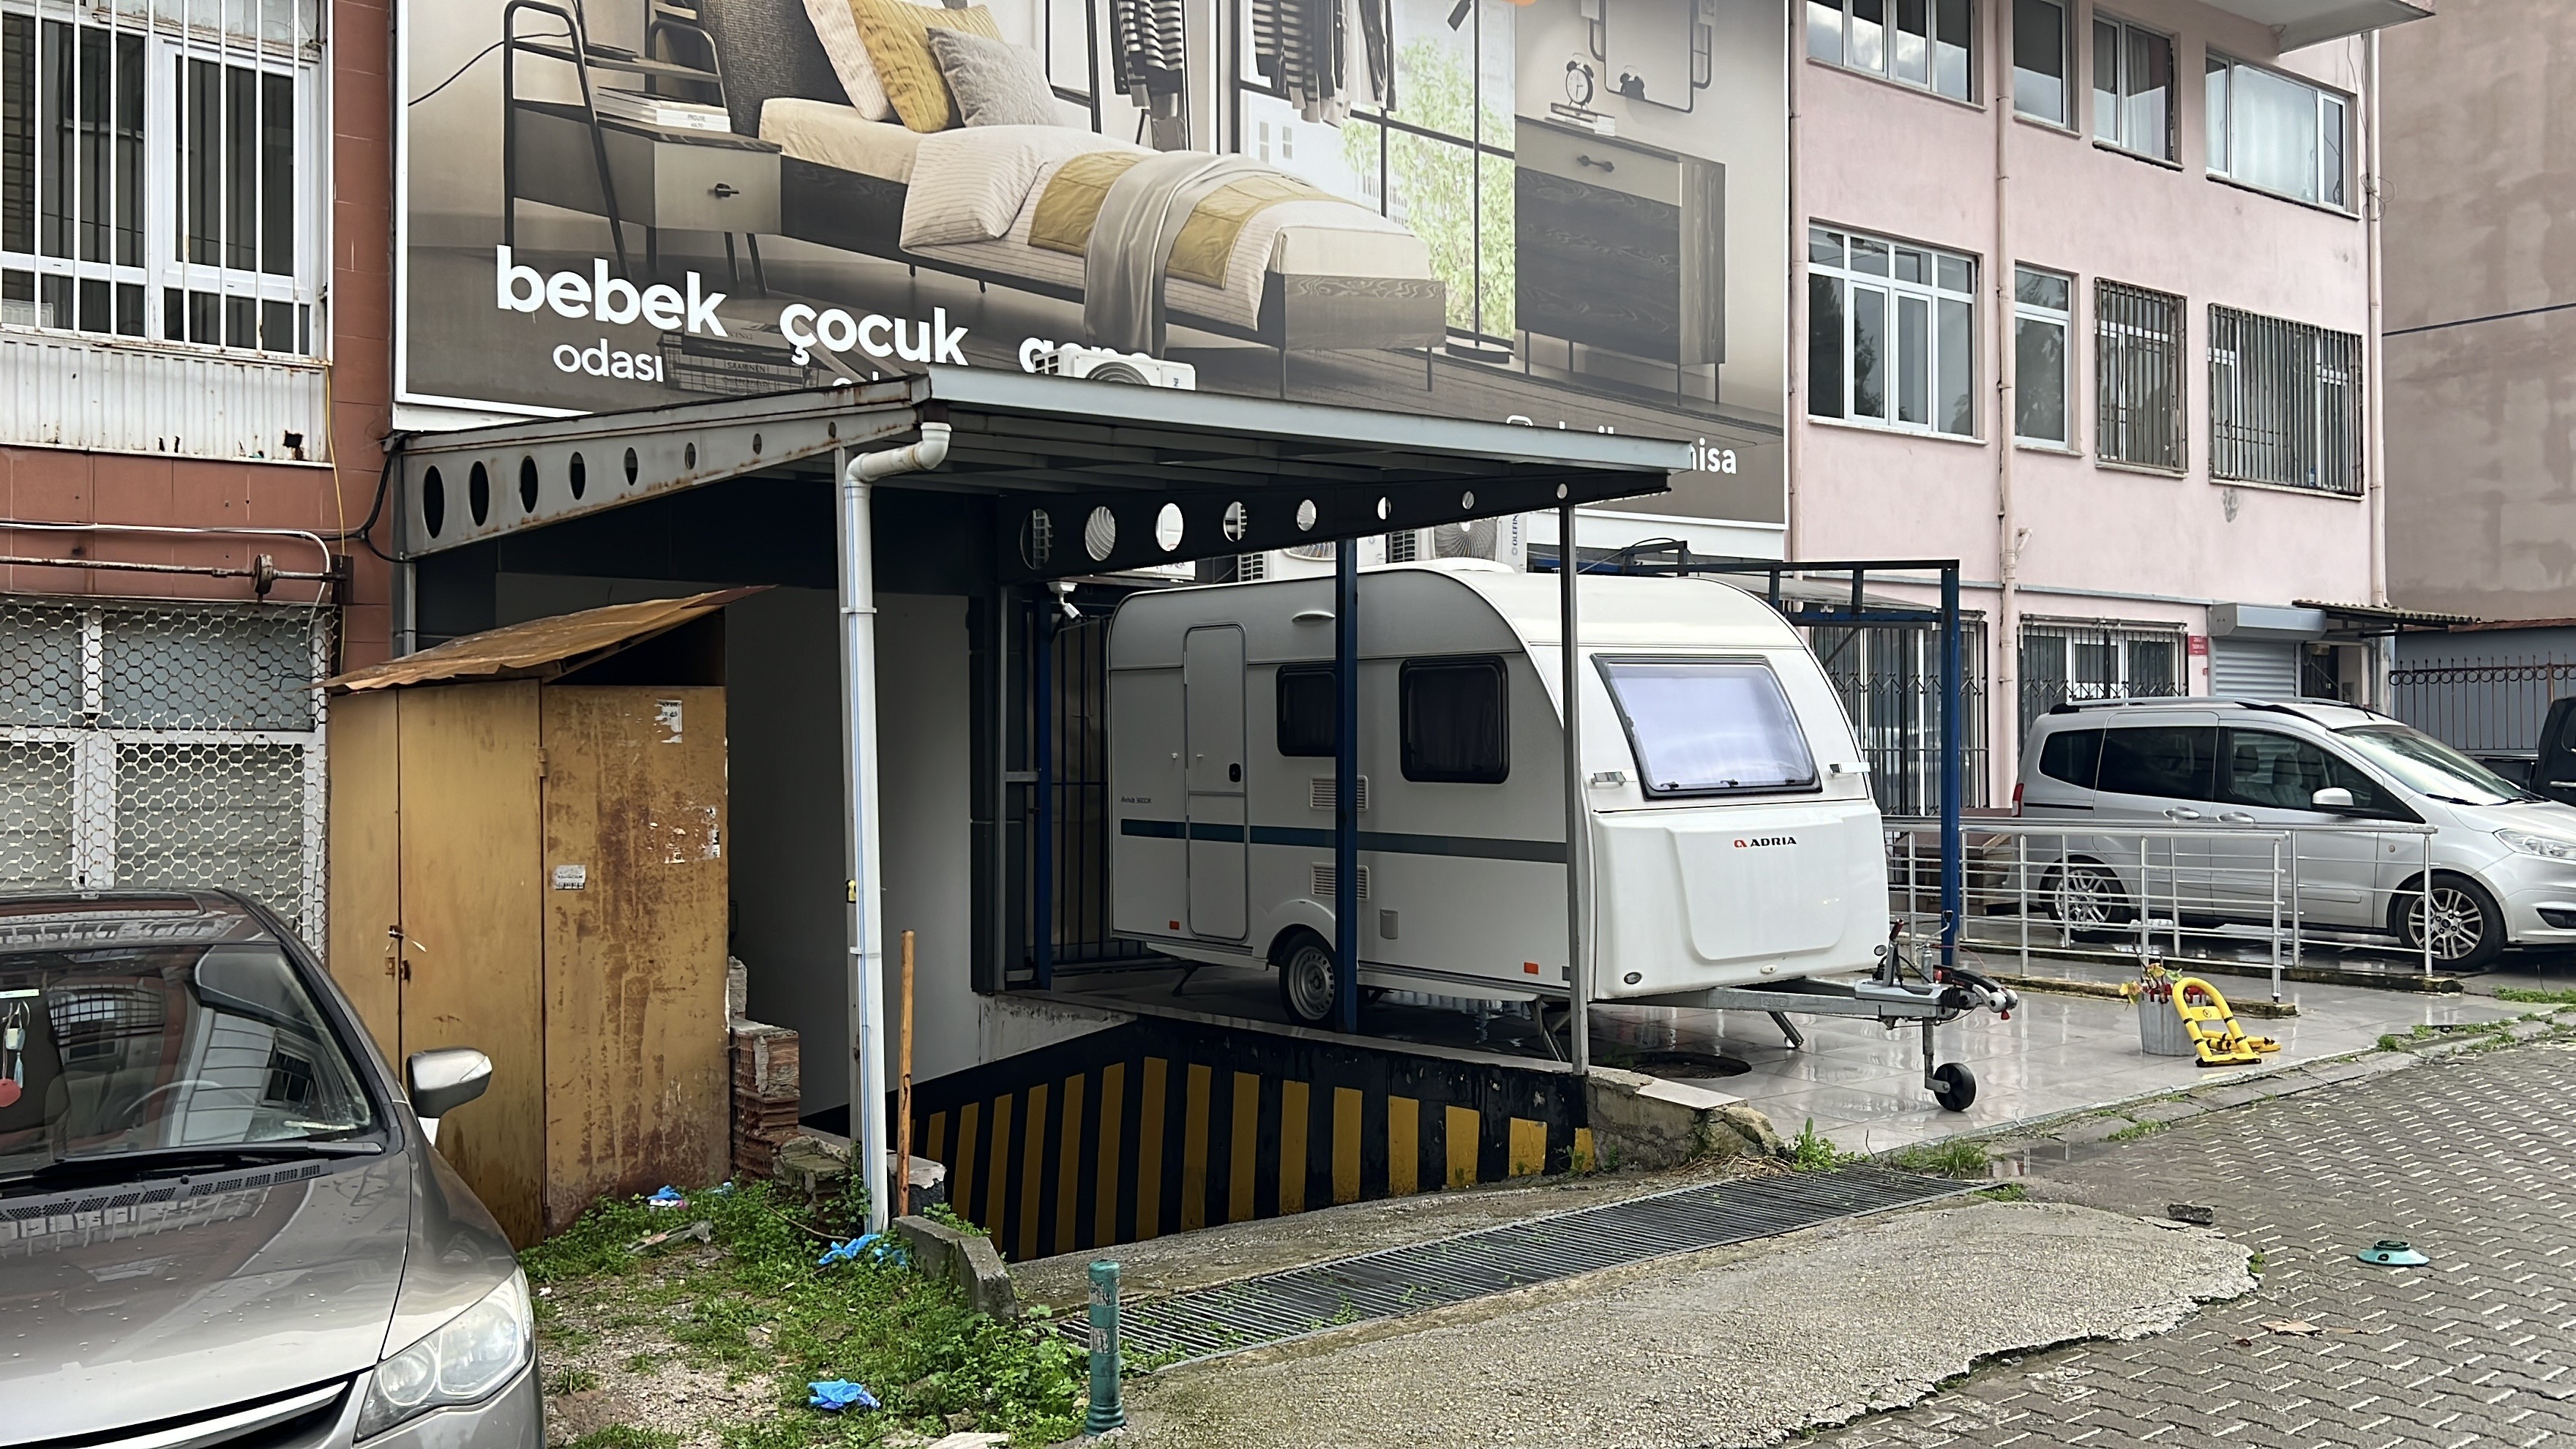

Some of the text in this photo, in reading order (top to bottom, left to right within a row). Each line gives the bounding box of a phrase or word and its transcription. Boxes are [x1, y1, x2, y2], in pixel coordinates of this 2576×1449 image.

[498, 245, 727, 337] bebek
[780, 304, 967, 365] çocuk
[554, 339, 663, 381] odası
[1751, 836, 1797, 847] ADRIA
